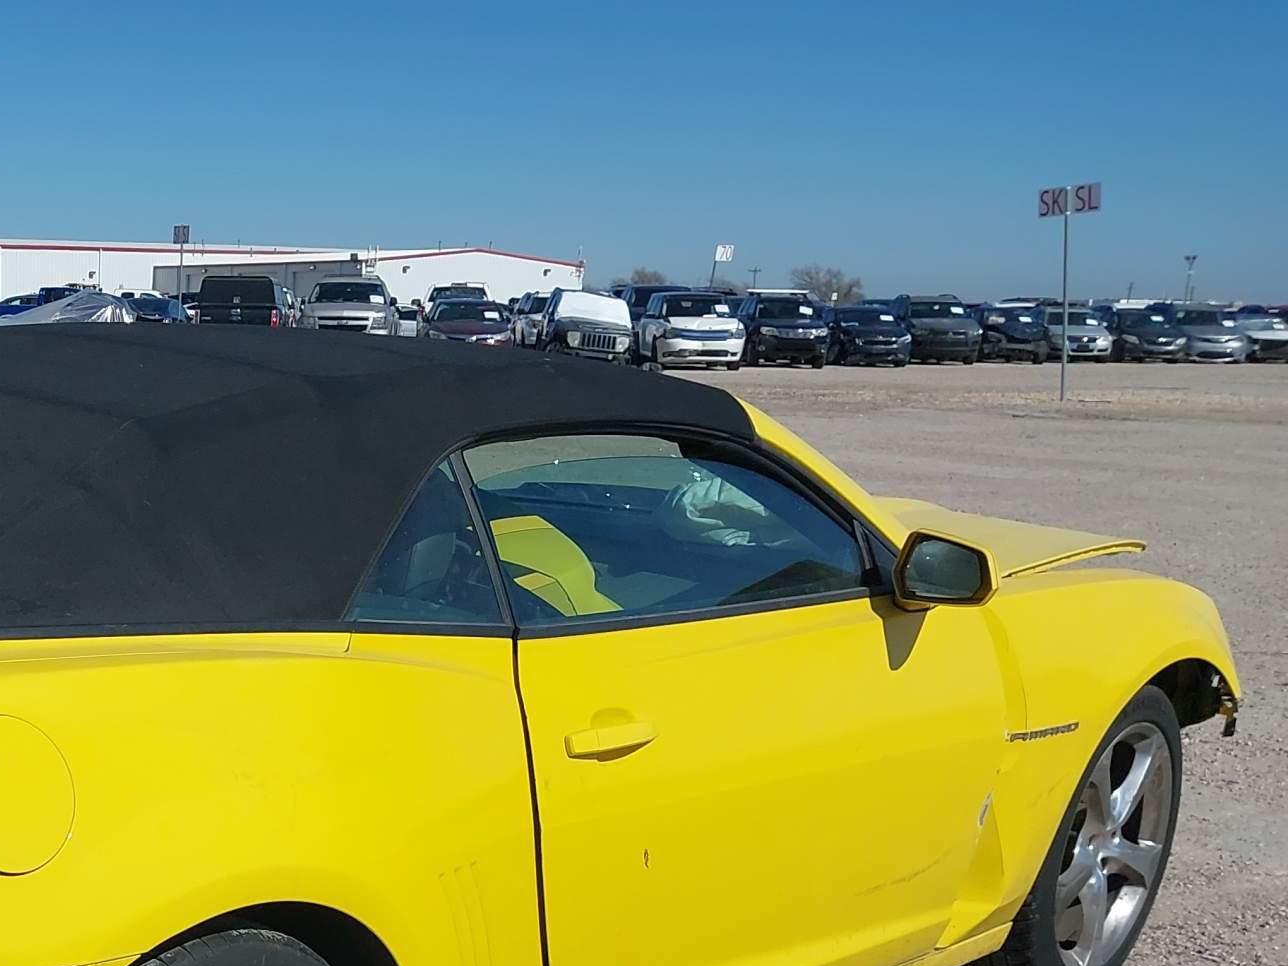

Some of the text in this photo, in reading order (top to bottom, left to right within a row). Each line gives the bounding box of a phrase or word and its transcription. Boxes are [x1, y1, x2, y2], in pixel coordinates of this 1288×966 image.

[1039, 189, 1064, 217] SK
[1074, 184, 1099, 212] SL
[719, 245, 733, 260] 70
